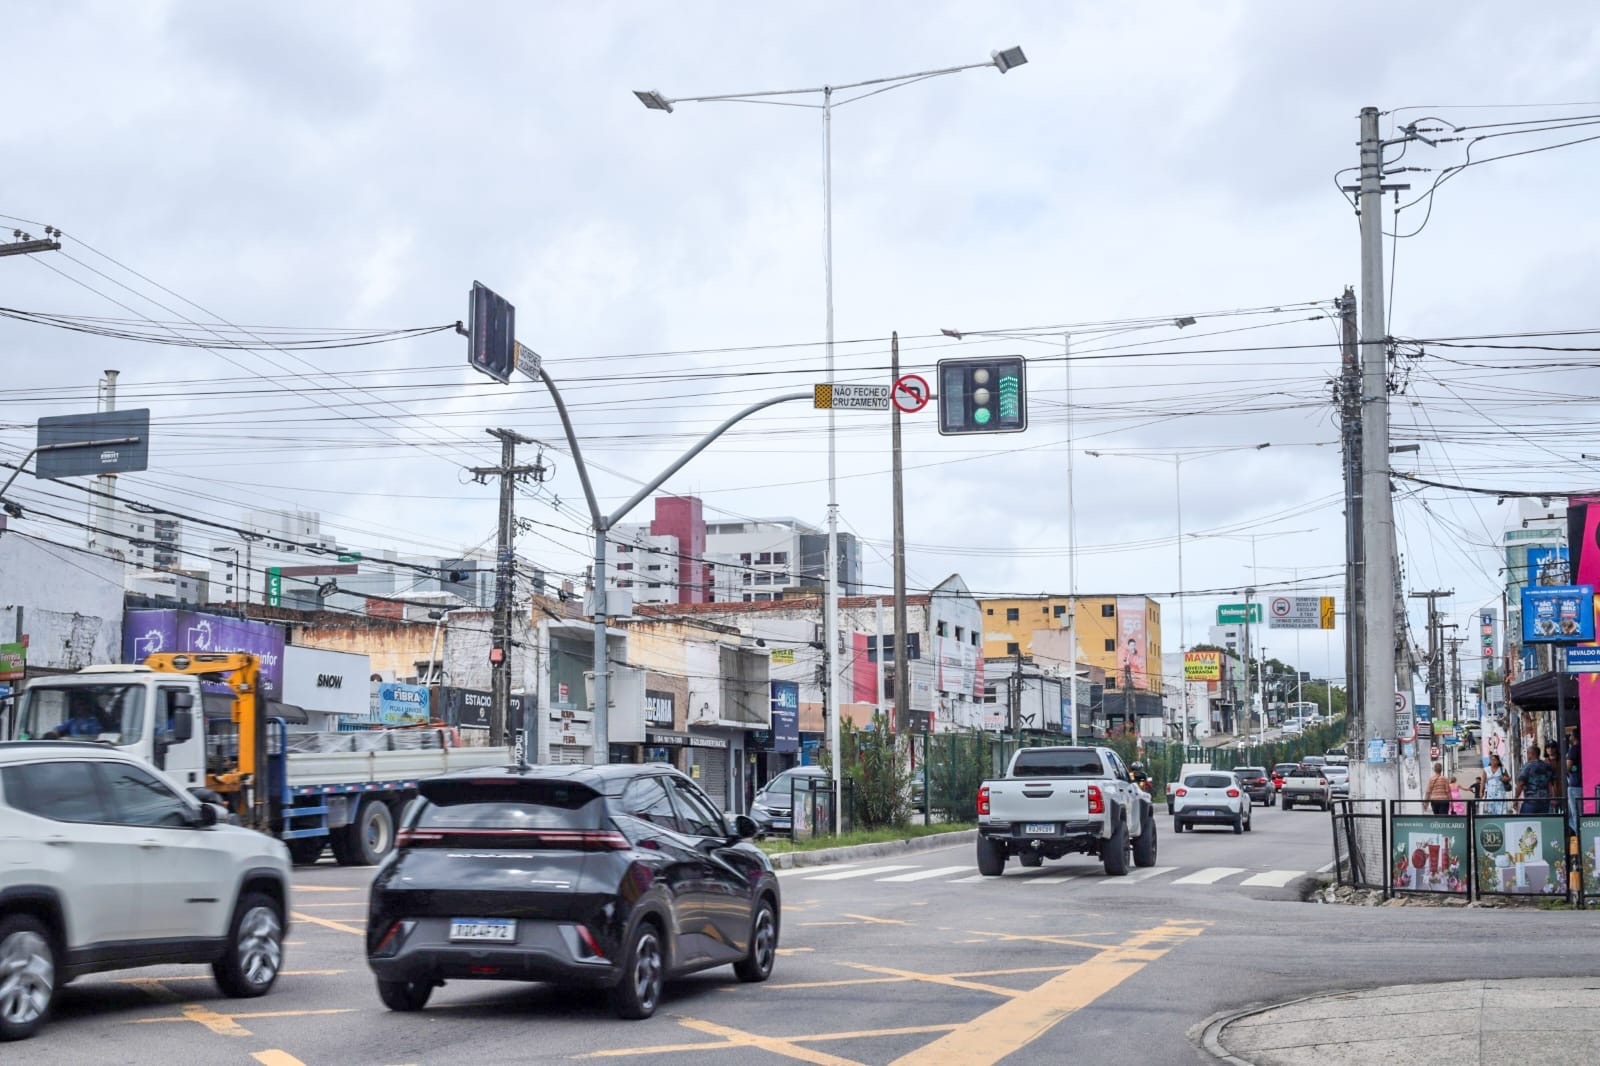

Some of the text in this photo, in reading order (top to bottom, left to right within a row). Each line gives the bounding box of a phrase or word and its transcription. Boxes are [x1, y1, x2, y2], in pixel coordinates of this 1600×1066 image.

[834, 386, 888, 397] NÃO FECHE O
[833, 398, 888, 407] CRUZAMENTO
[317, 674, 342, 689] SNOW
